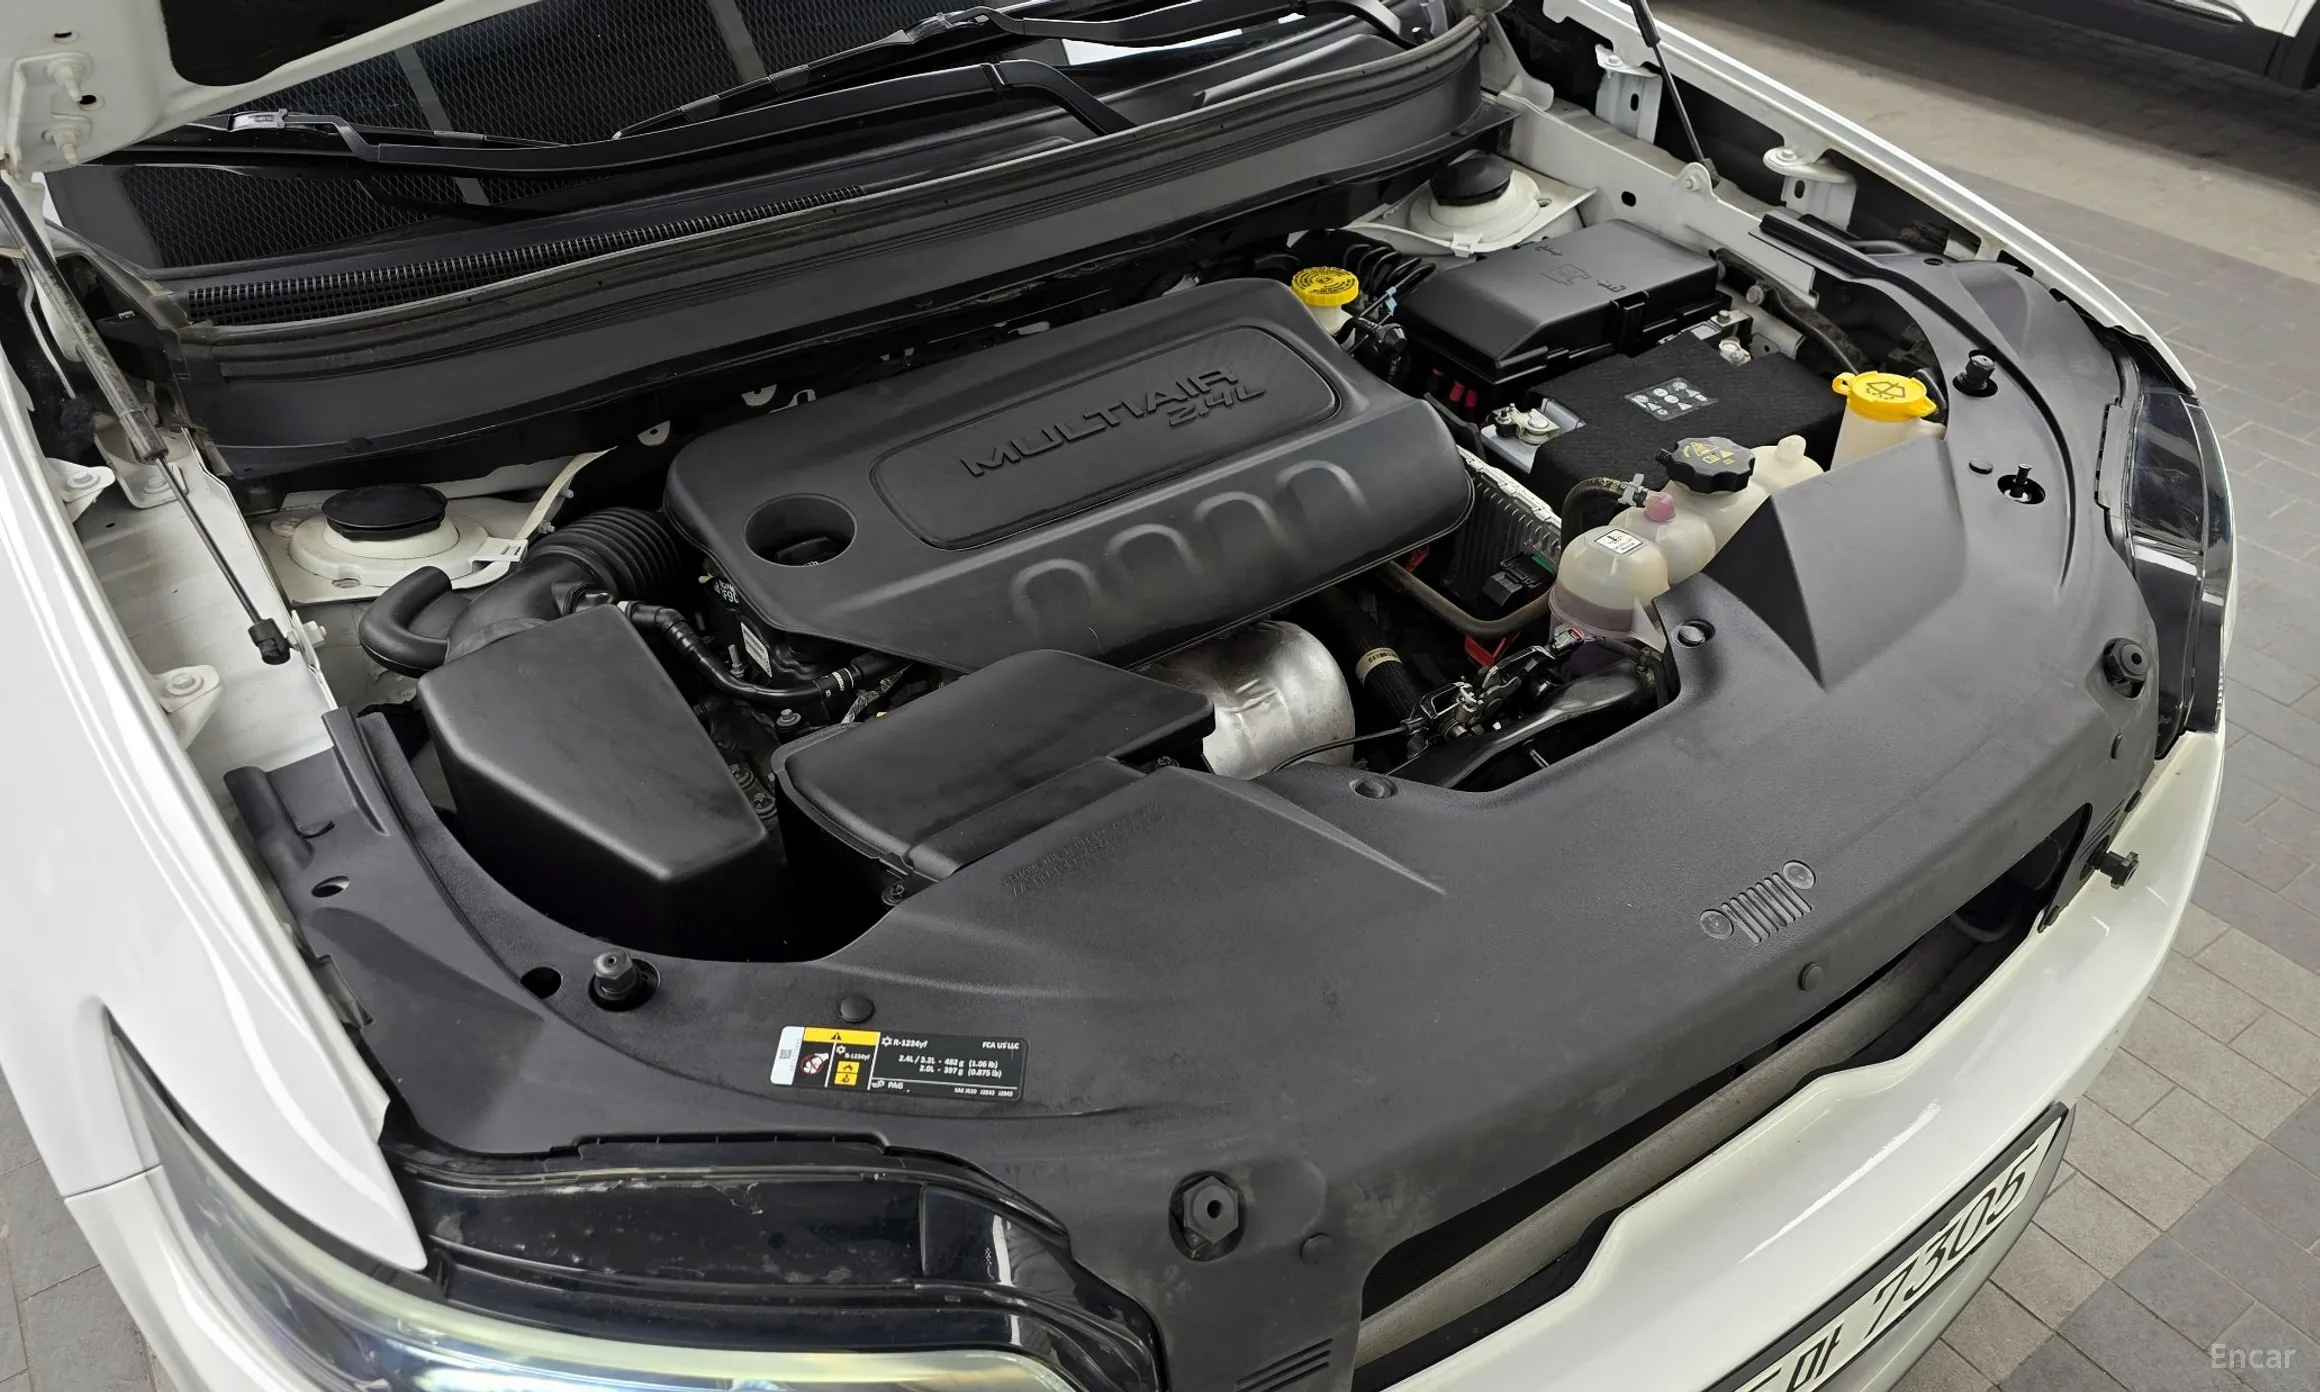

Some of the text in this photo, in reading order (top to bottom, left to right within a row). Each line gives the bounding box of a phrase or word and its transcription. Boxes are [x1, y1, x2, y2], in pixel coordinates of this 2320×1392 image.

[1168, 384, 1266, 428] 2.4L
[960, 366, 1240, 477] MULTIAIR
[893, 1038, 928, 1049] R-1234yf
[982, 1041, 1020, 1050] FCA US LLC
[898, 1054, 914, 1063] 2.4L
[919, 1065, 934, 1073] 2.0L
[1864, 1143, 2039, 1339] 7305
